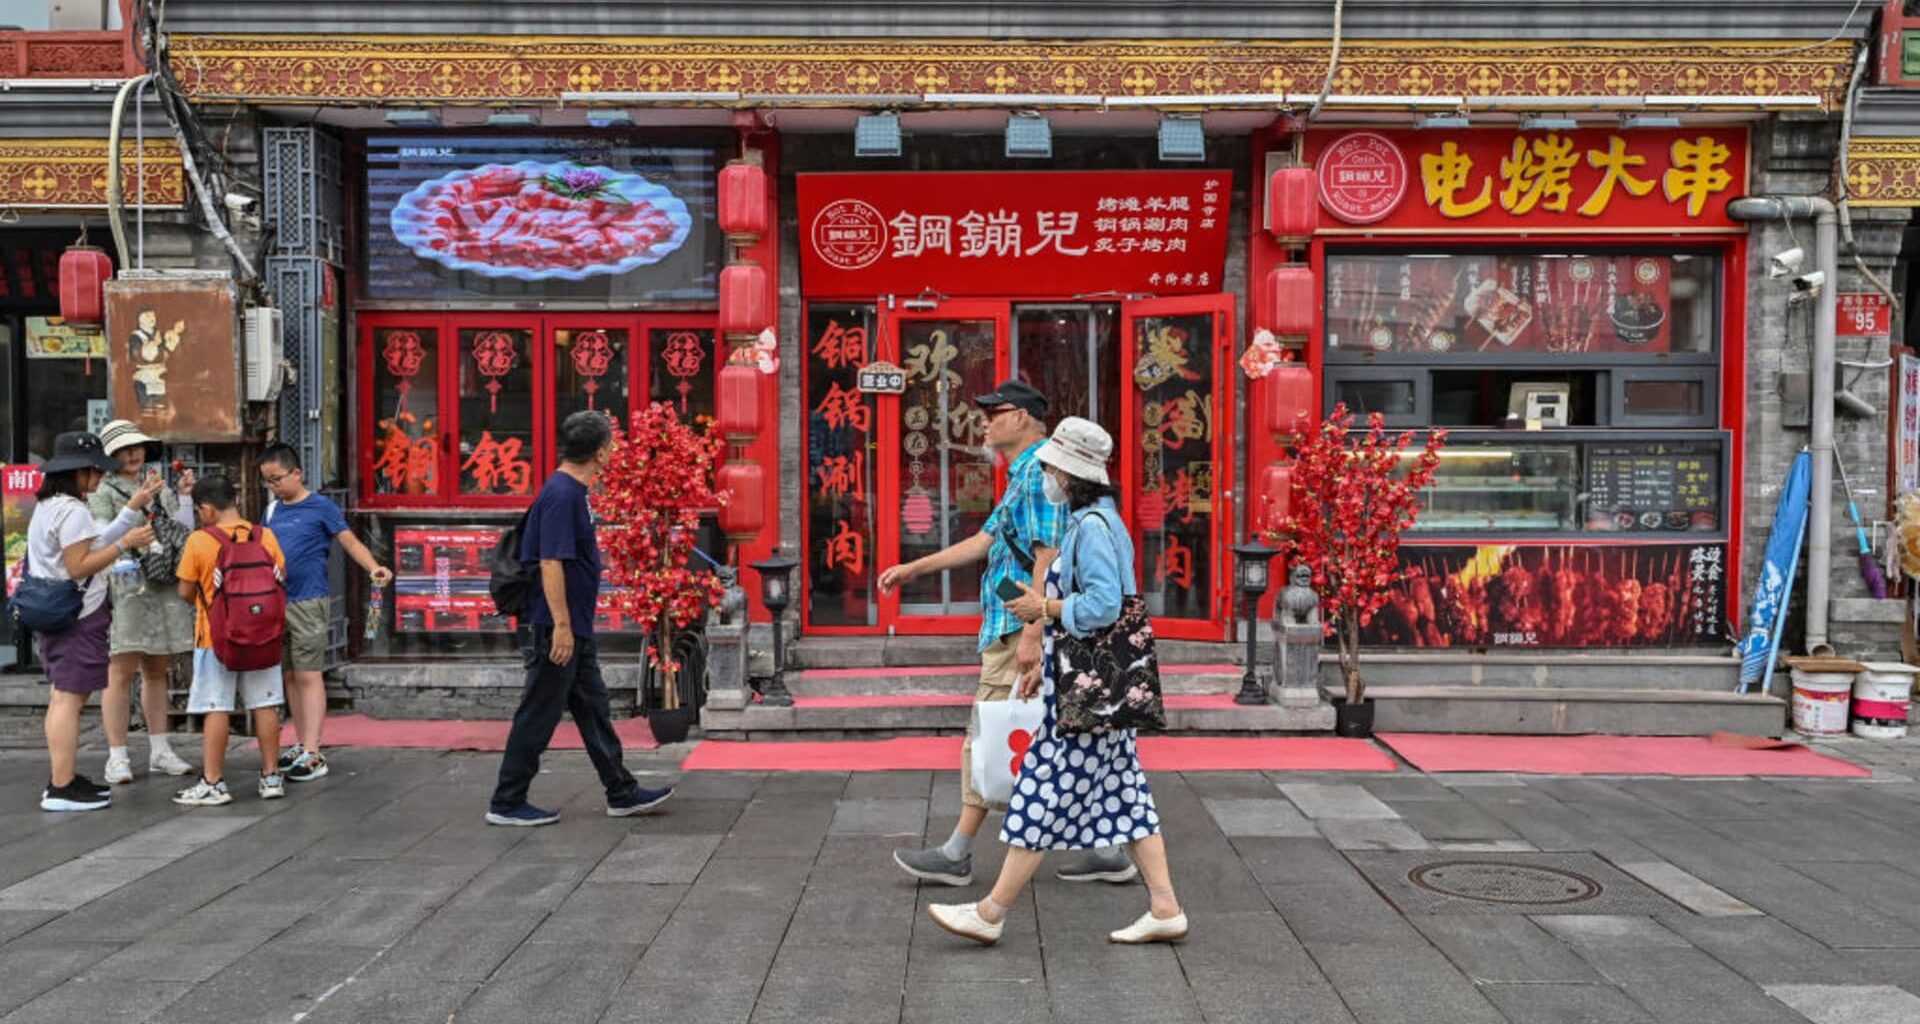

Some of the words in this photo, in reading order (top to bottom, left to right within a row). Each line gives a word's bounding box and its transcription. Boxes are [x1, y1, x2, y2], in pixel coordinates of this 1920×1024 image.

[1420, 134, 1732, 217] 电烤大串
[1093, 237, 1187, 253] 炙子烤肉
[1855, 311, 1876, 331] 95
[862, 374, 901, 387] 营业中
